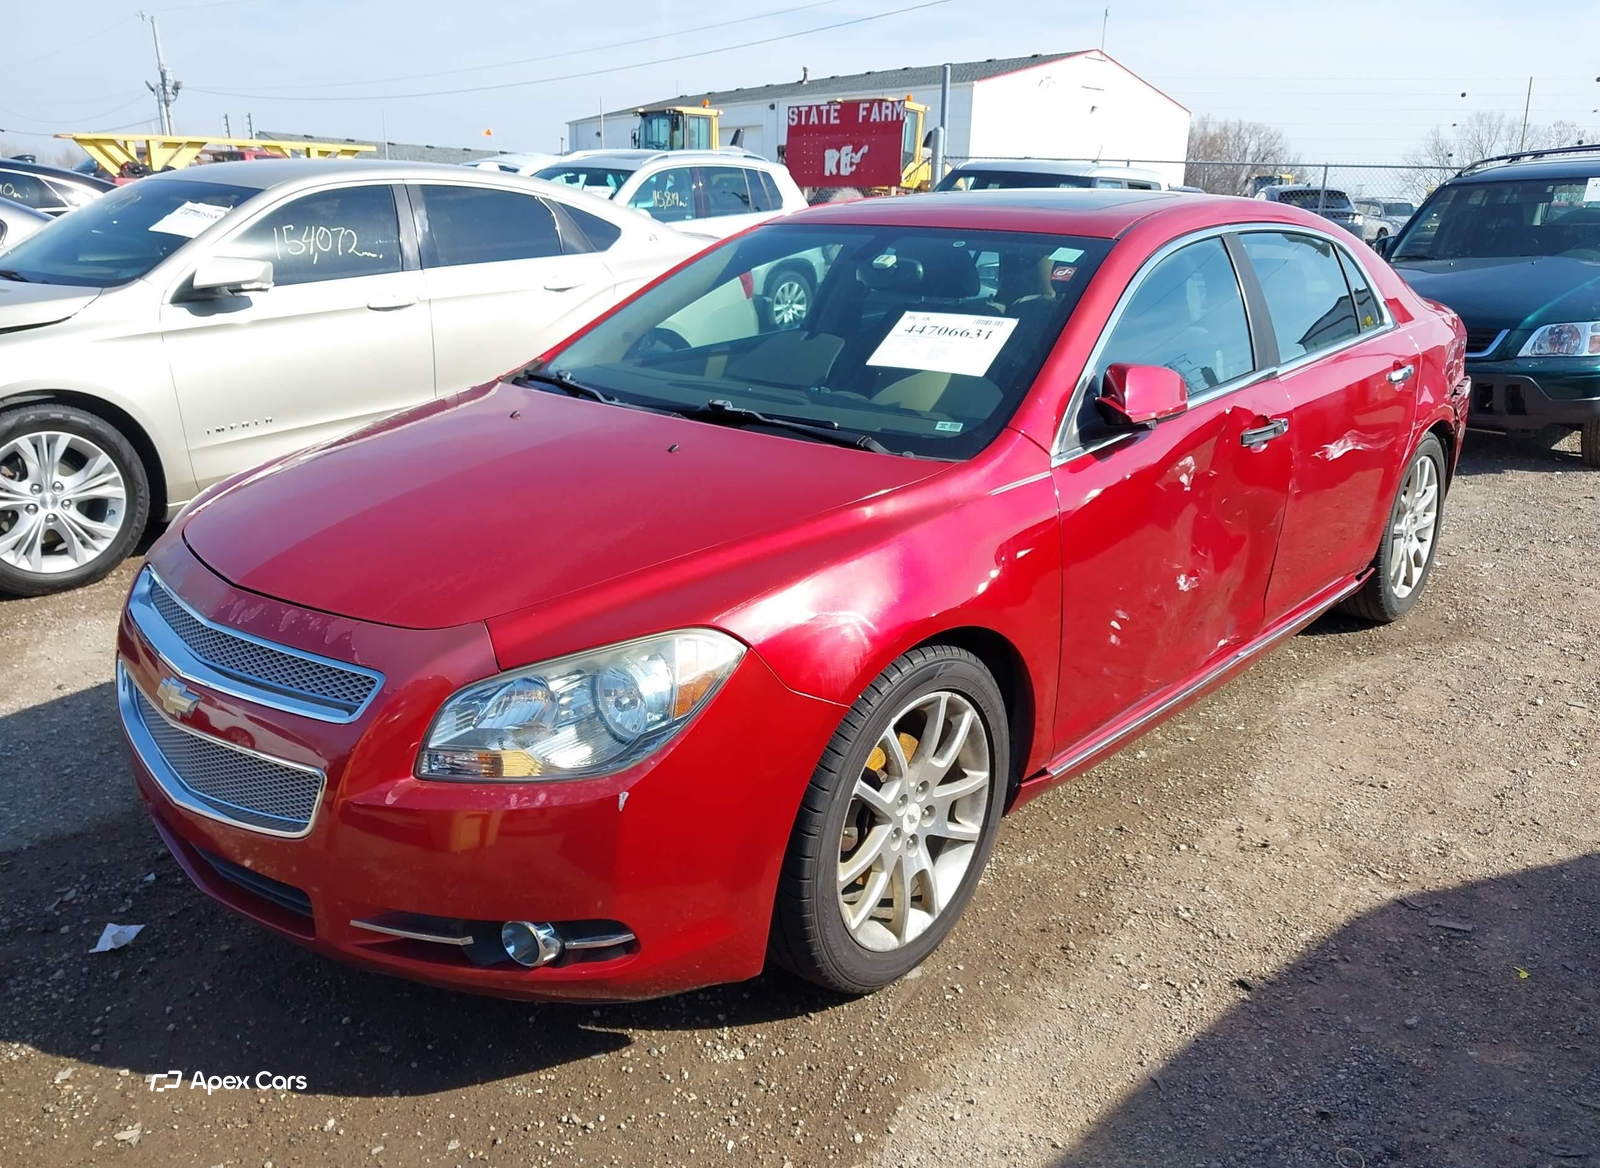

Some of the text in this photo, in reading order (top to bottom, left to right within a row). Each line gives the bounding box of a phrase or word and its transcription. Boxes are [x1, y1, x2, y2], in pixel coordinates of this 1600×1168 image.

[788, 100, 904, 126] STATE FARM
[904, 324, 993, 340] 44706631
